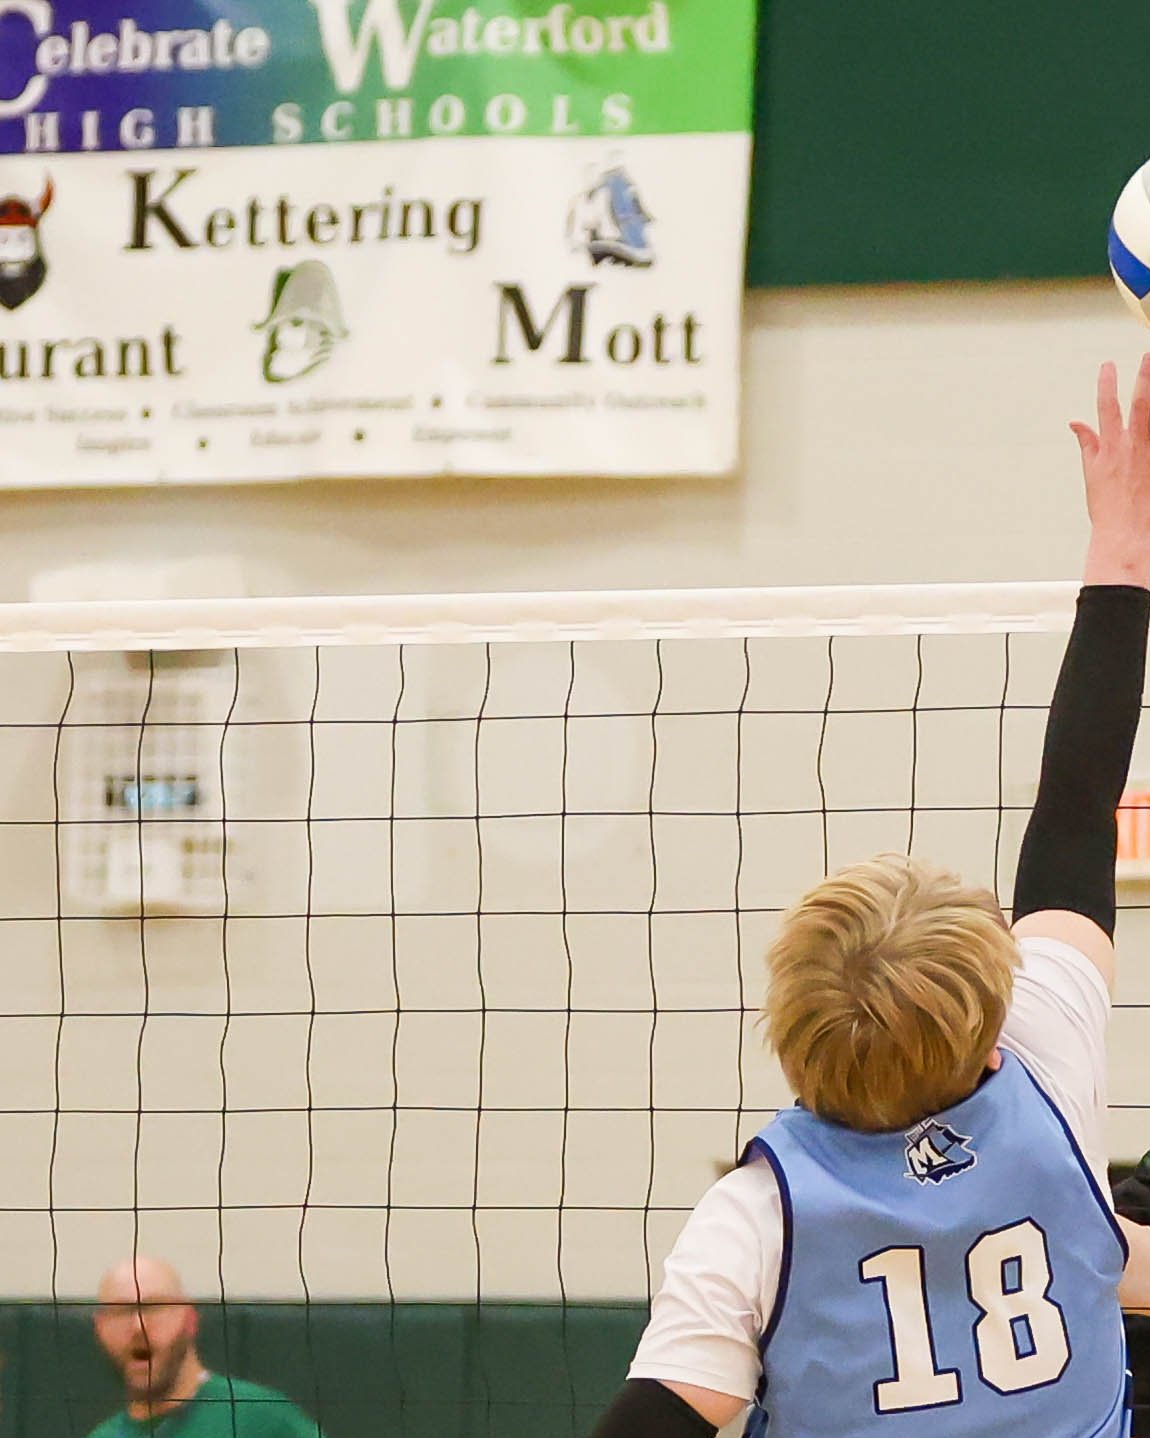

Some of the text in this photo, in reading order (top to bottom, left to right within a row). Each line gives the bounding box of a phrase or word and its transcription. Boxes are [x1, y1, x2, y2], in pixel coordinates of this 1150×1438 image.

[310, 0, 672, 93] Waterford
[24, 92, 634, 152] HIGH SCHOOLS
[123, 167, 487, 253] Kettering
[491, 281, 704, 367] Mott
[858, 1216, 1072, 1415] 18
